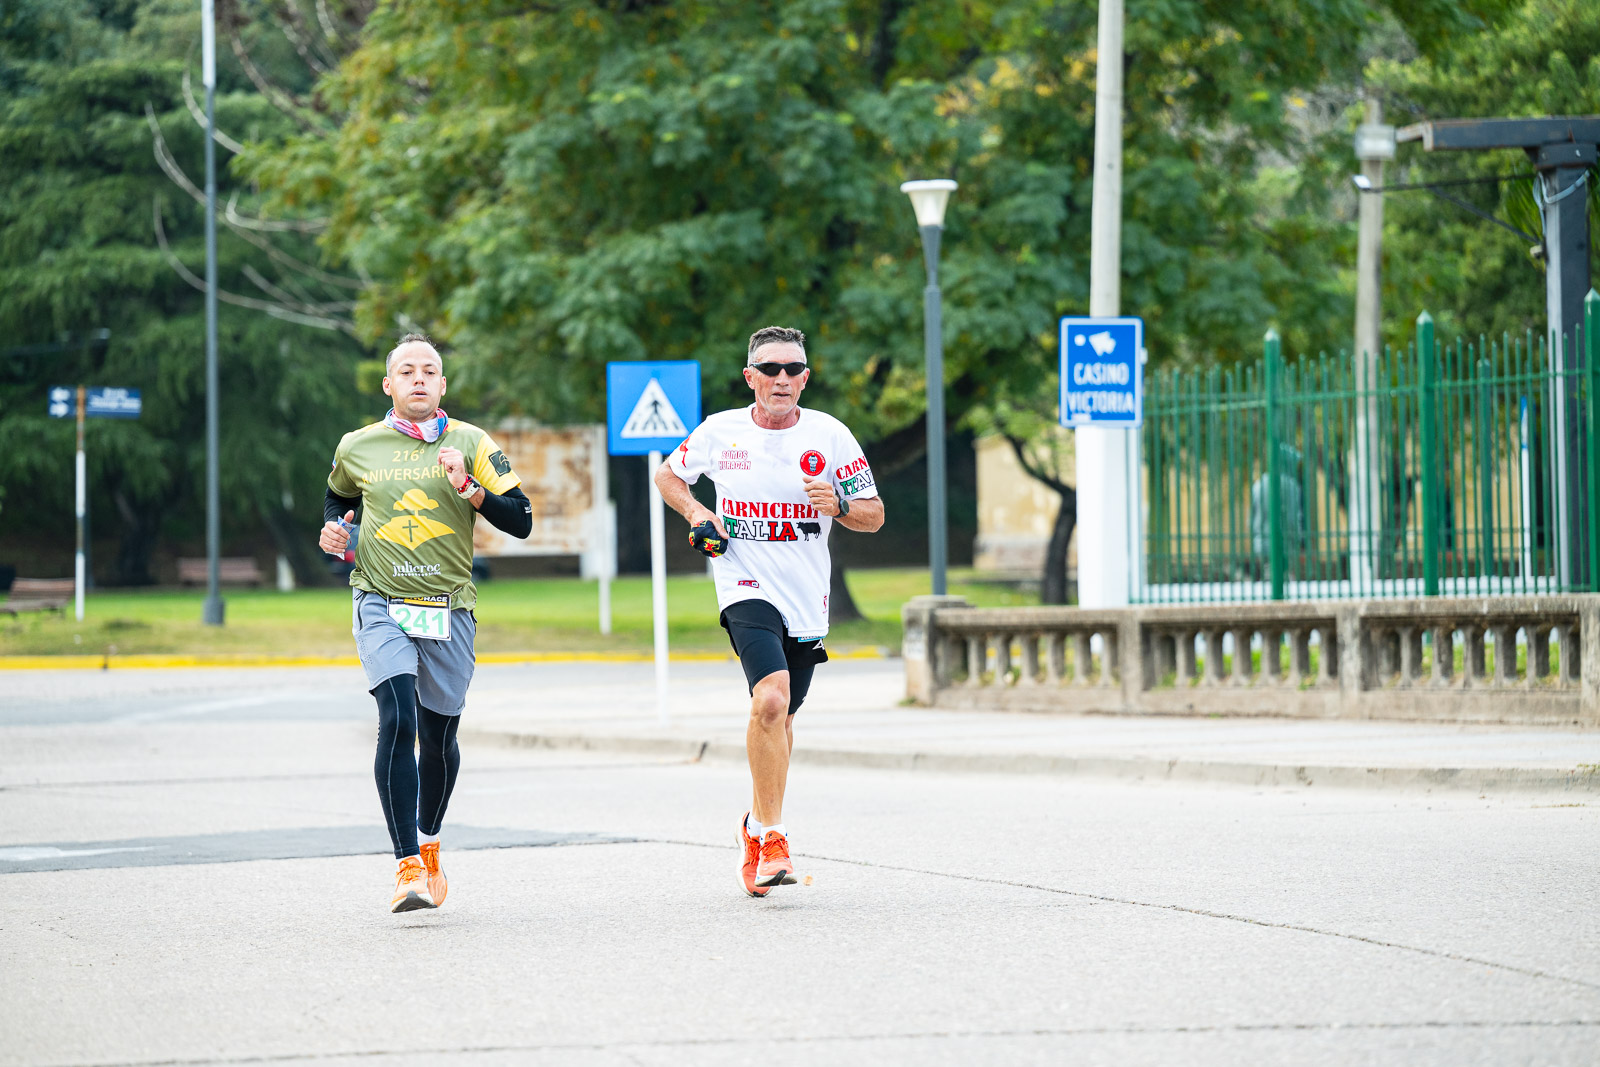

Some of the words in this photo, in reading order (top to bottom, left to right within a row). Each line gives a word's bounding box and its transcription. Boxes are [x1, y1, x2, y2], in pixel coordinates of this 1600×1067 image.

[1074, 362, 1129, 386] CASINO
[1068, 390, 1134, 413] VICTORIA
[721, 450, 748, 460] SOMOS
[361, 465, 448, 484] ANIVERSARI
[723, 515, 798, 541] ITALIA
[395, 607, 444, 635] 241
